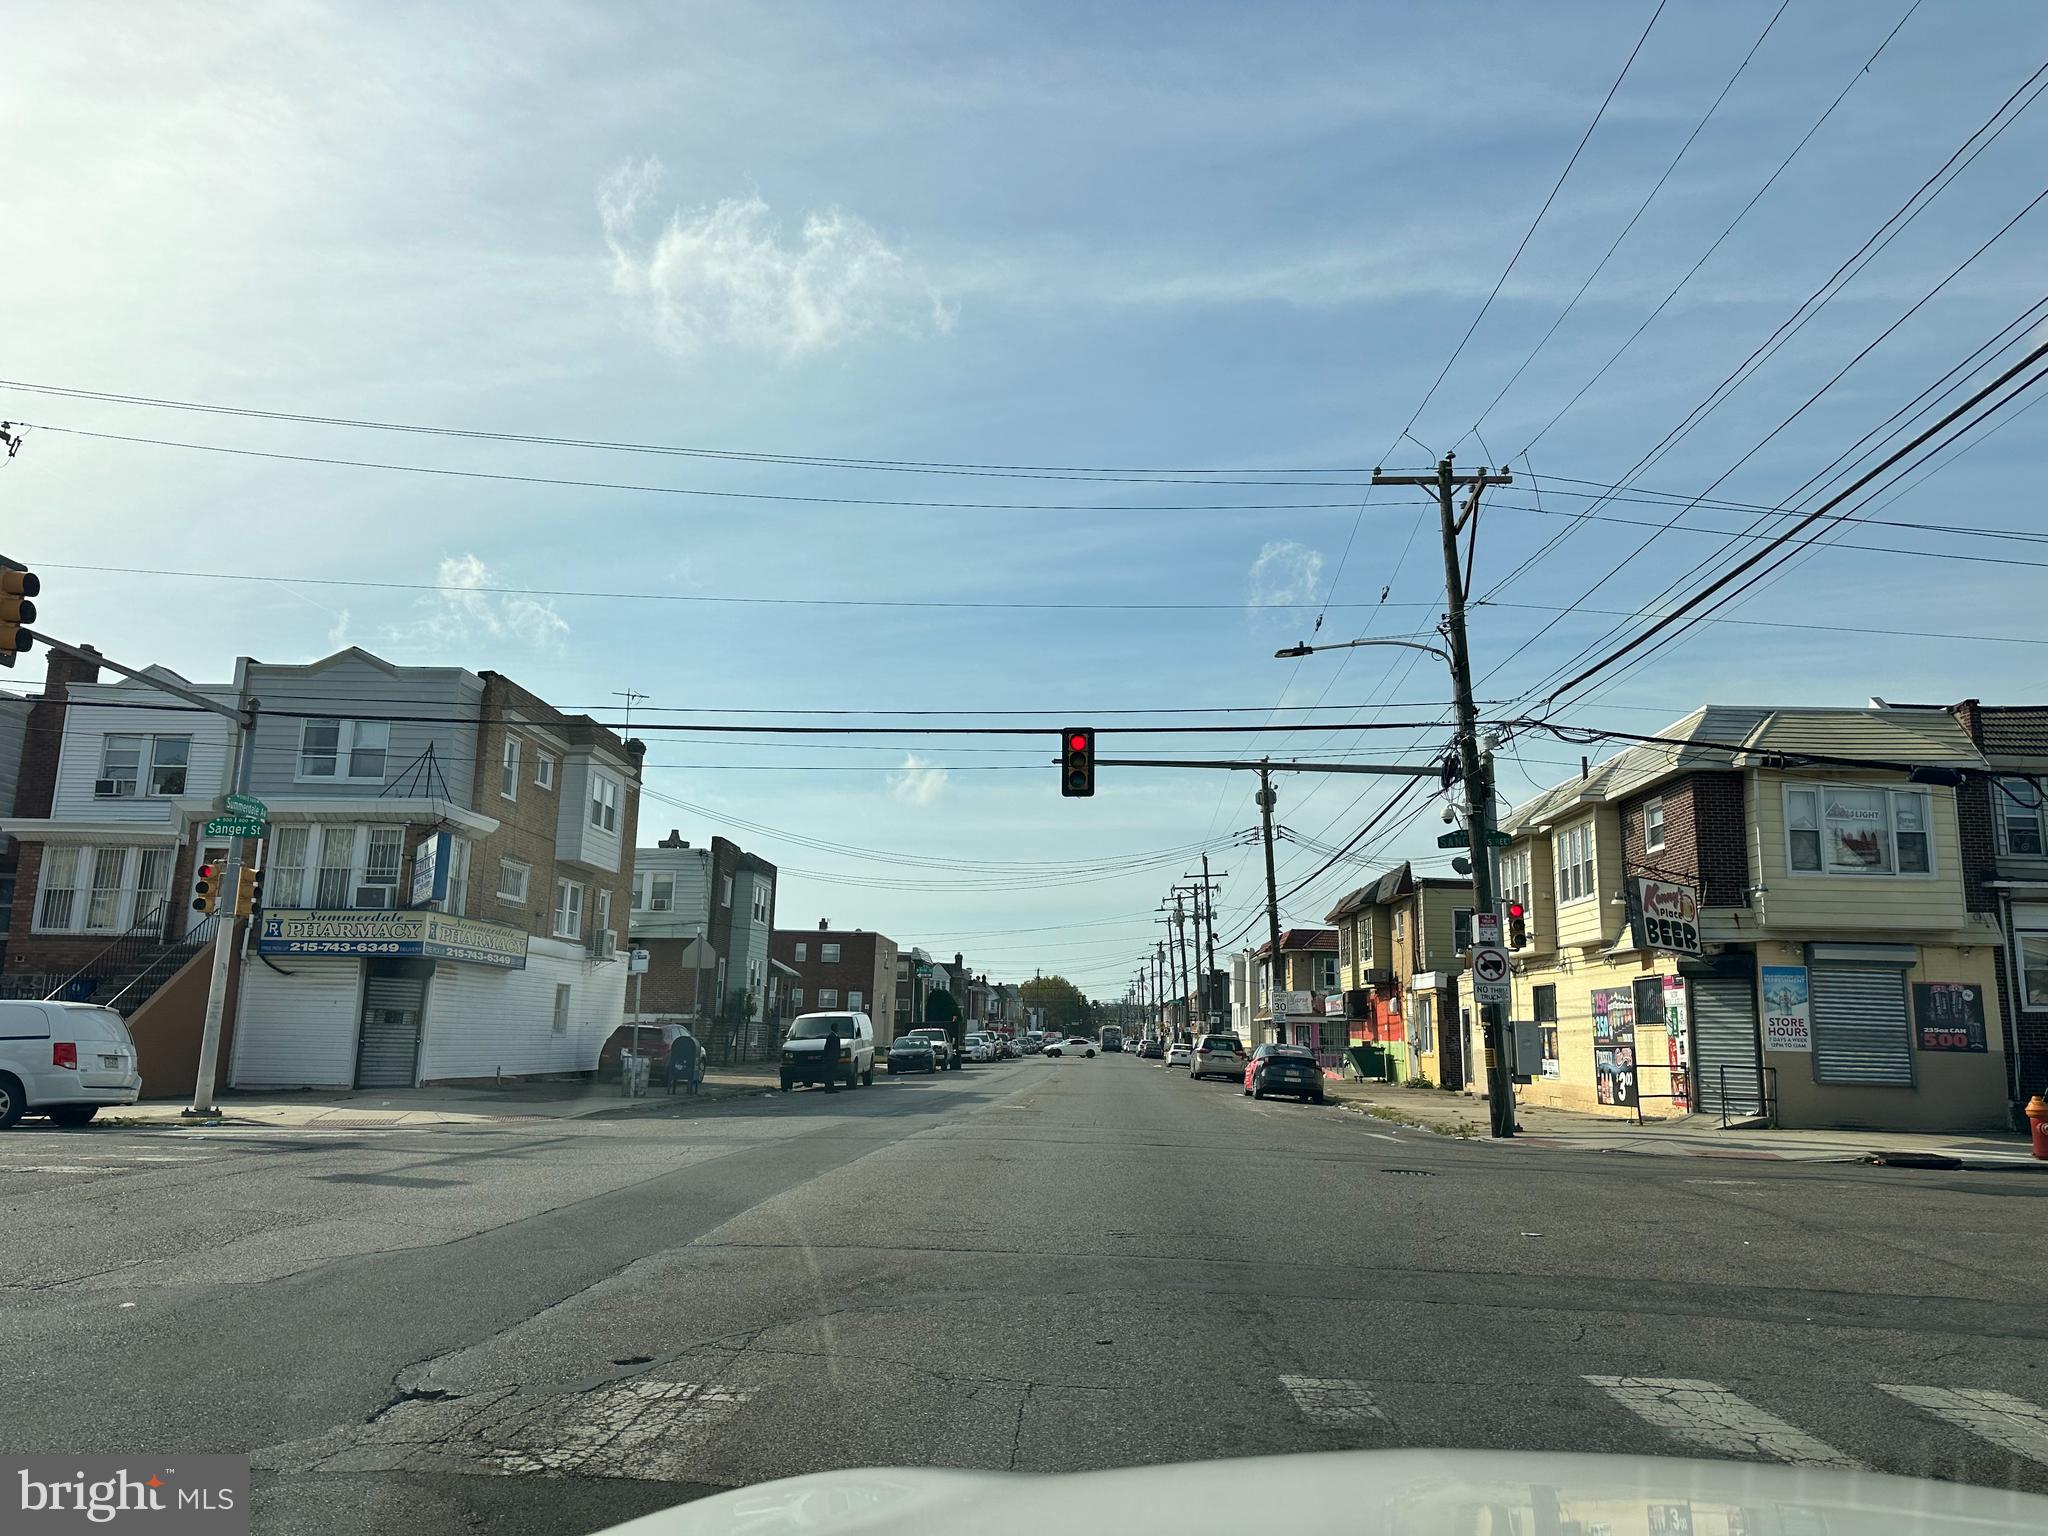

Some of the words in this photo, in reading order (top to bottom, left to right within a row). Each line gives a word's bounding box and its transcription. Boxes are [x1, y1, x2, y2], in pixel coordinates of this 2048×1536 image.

[1855, 810, 1880, 819] LIGHT
[208, 822, 247, 836] Sanger
[250, 824, 261, 835] St
[1440, 836, 1469, 847] SANG
[306, 911, 404, 922] Summerdale
[1660, 907, 1684, 920] Place
[287, 922, 423, 939] PHARMACY
[456, 919, 516, 938] Summerdale
[1645, 917, 1698, 950] BEER
[440, 926, 526, 954] PHARMACY
[289, 942, 400, 953] 215-743-6349
[446, 947, 511, 964] 215-743-6349
[1476, 985, 1489, 994] NO
[1274, 1002, 1287, 1011] 30
[1768, 1017, 1805, 1028] STORE
[1768, 1027, 1809, 1038] HOURS
